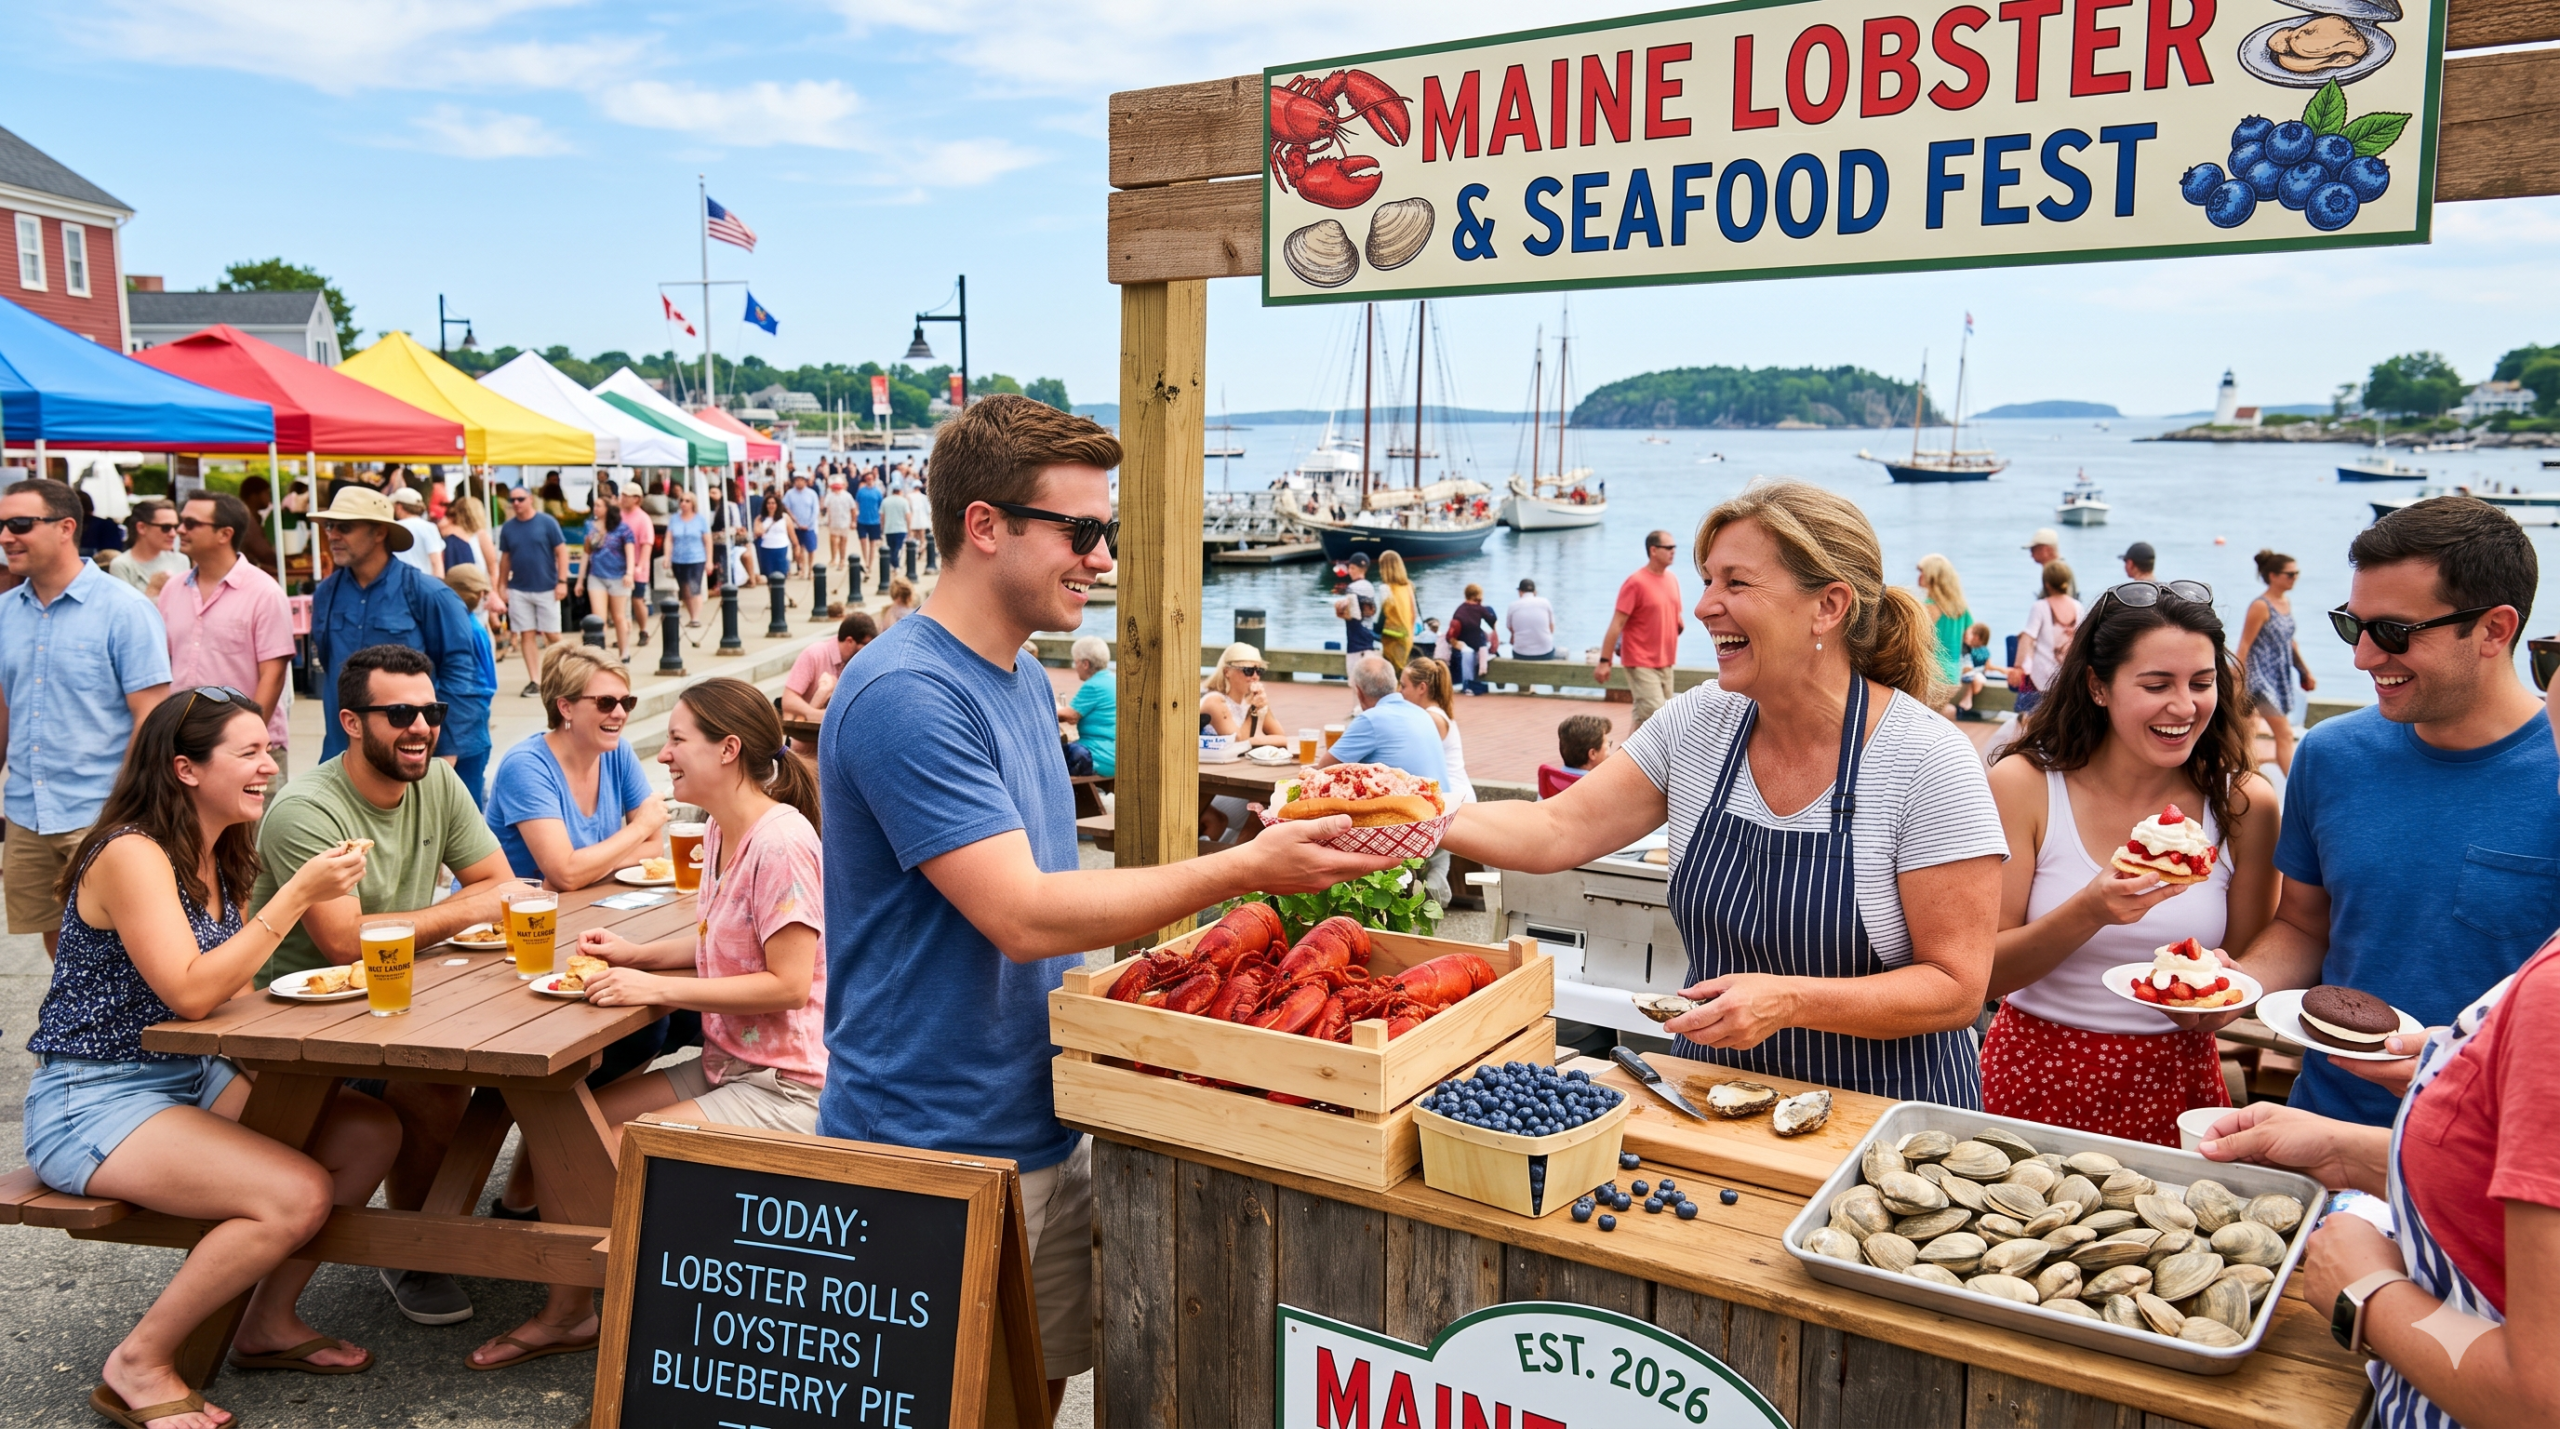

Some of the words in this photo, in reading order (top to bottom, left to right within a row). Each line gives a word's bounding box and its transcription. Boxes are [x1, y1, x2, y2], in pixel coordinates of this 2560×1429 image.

[1420, 43, 1694, 163] MAINE
[1731, 0, 2218, 132] LOBSTER
[1452, 182, 1498, 261] &
[1522, 149, 1890, 257] SEAFOOD
[1926, 122, 2160, 230] FEST
[735, 1192, 868, 1247] TODAY:
[661, 1251, 807, 1308] LOBSTER
[821, 1276, 930, 1329] ROLLS
[713, 1310, 861, 1369] OYSTERS
[1514, 1332, 1595, 1380] EST.
[1609, 1346, 1711, 1425] 2026
[652, 1348, 848, 1418] BLUEBERRY
[859, 1385, 915, 1429] PIE
